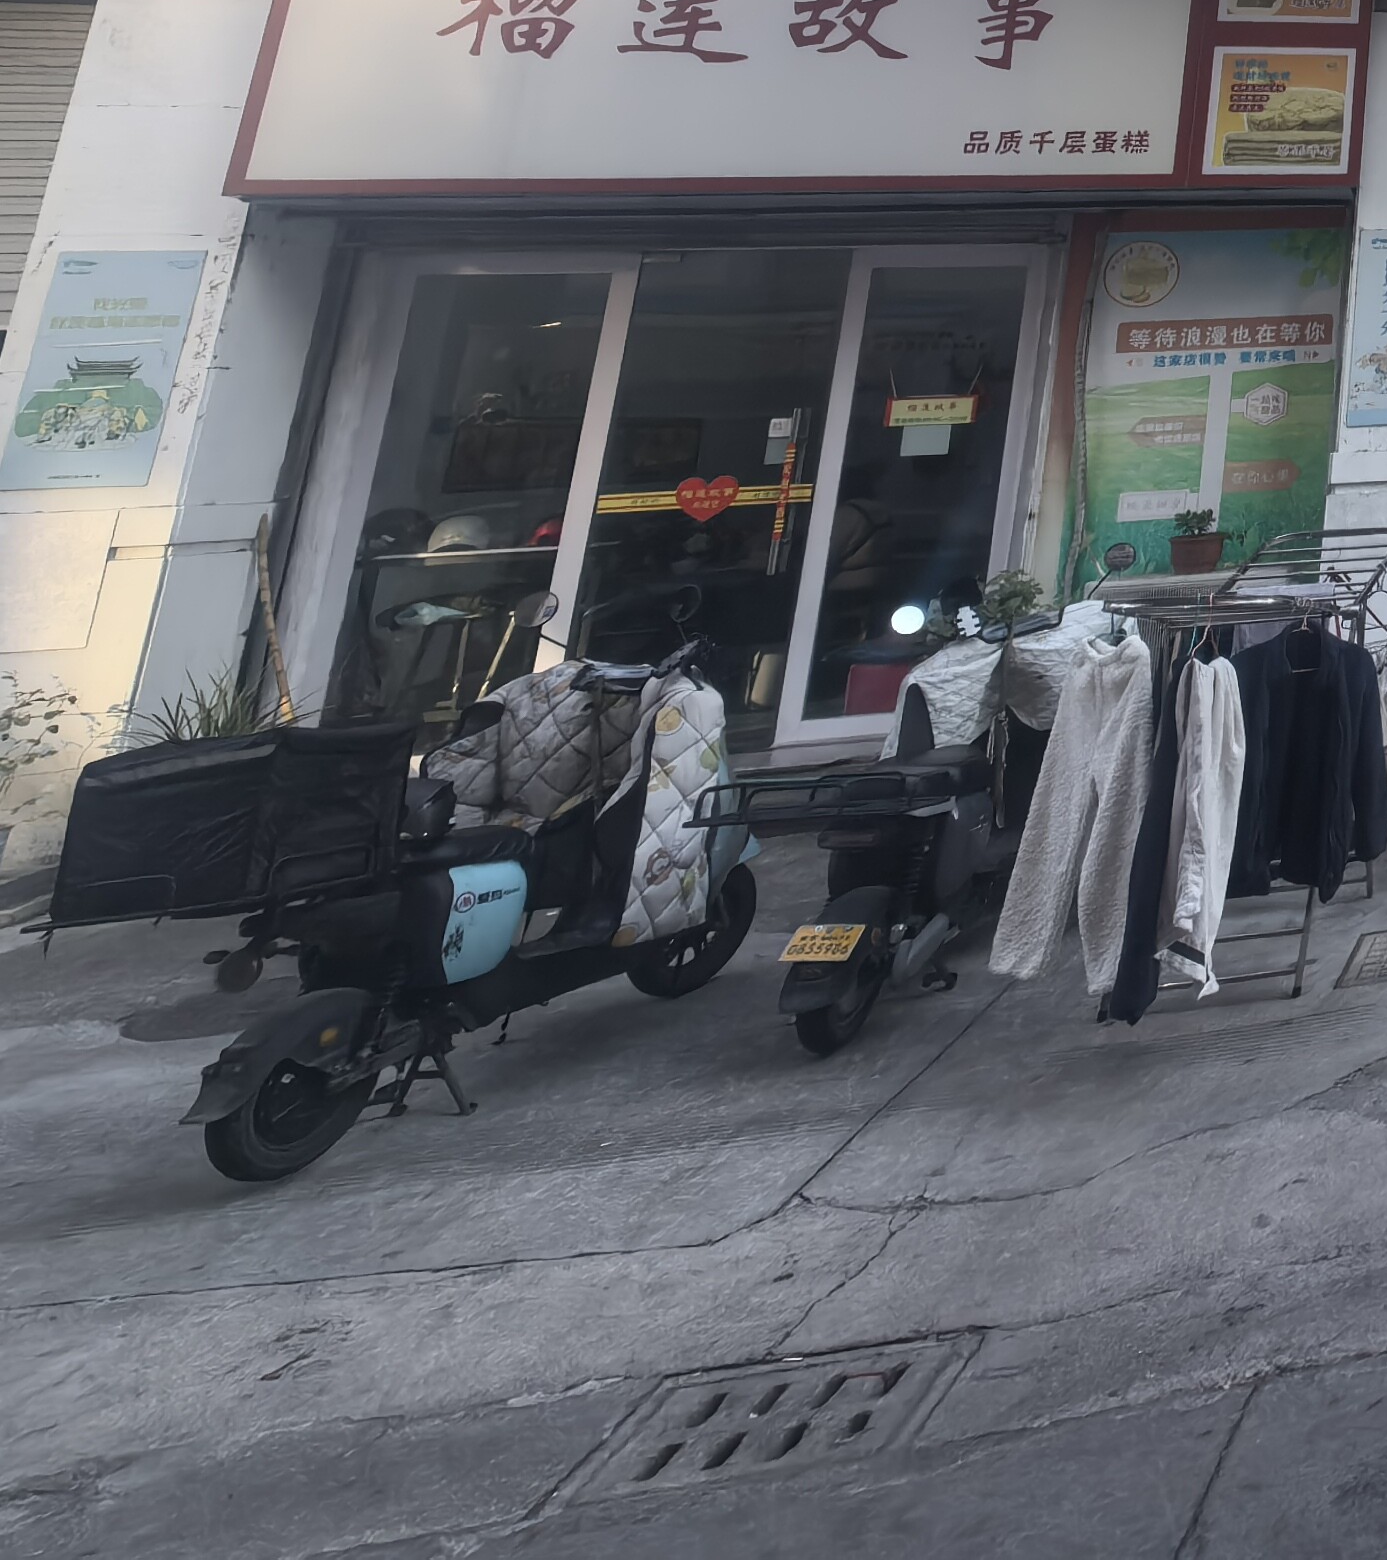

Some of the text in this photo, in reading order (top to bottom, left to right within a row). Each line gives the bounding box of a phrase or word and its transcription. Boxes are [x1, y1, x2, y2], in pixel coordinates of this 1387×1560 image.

[963, 130, 1150, 157] 品质千层蛋糕
[1129, 321, 1325, 350] 等待浪漫也在等你
